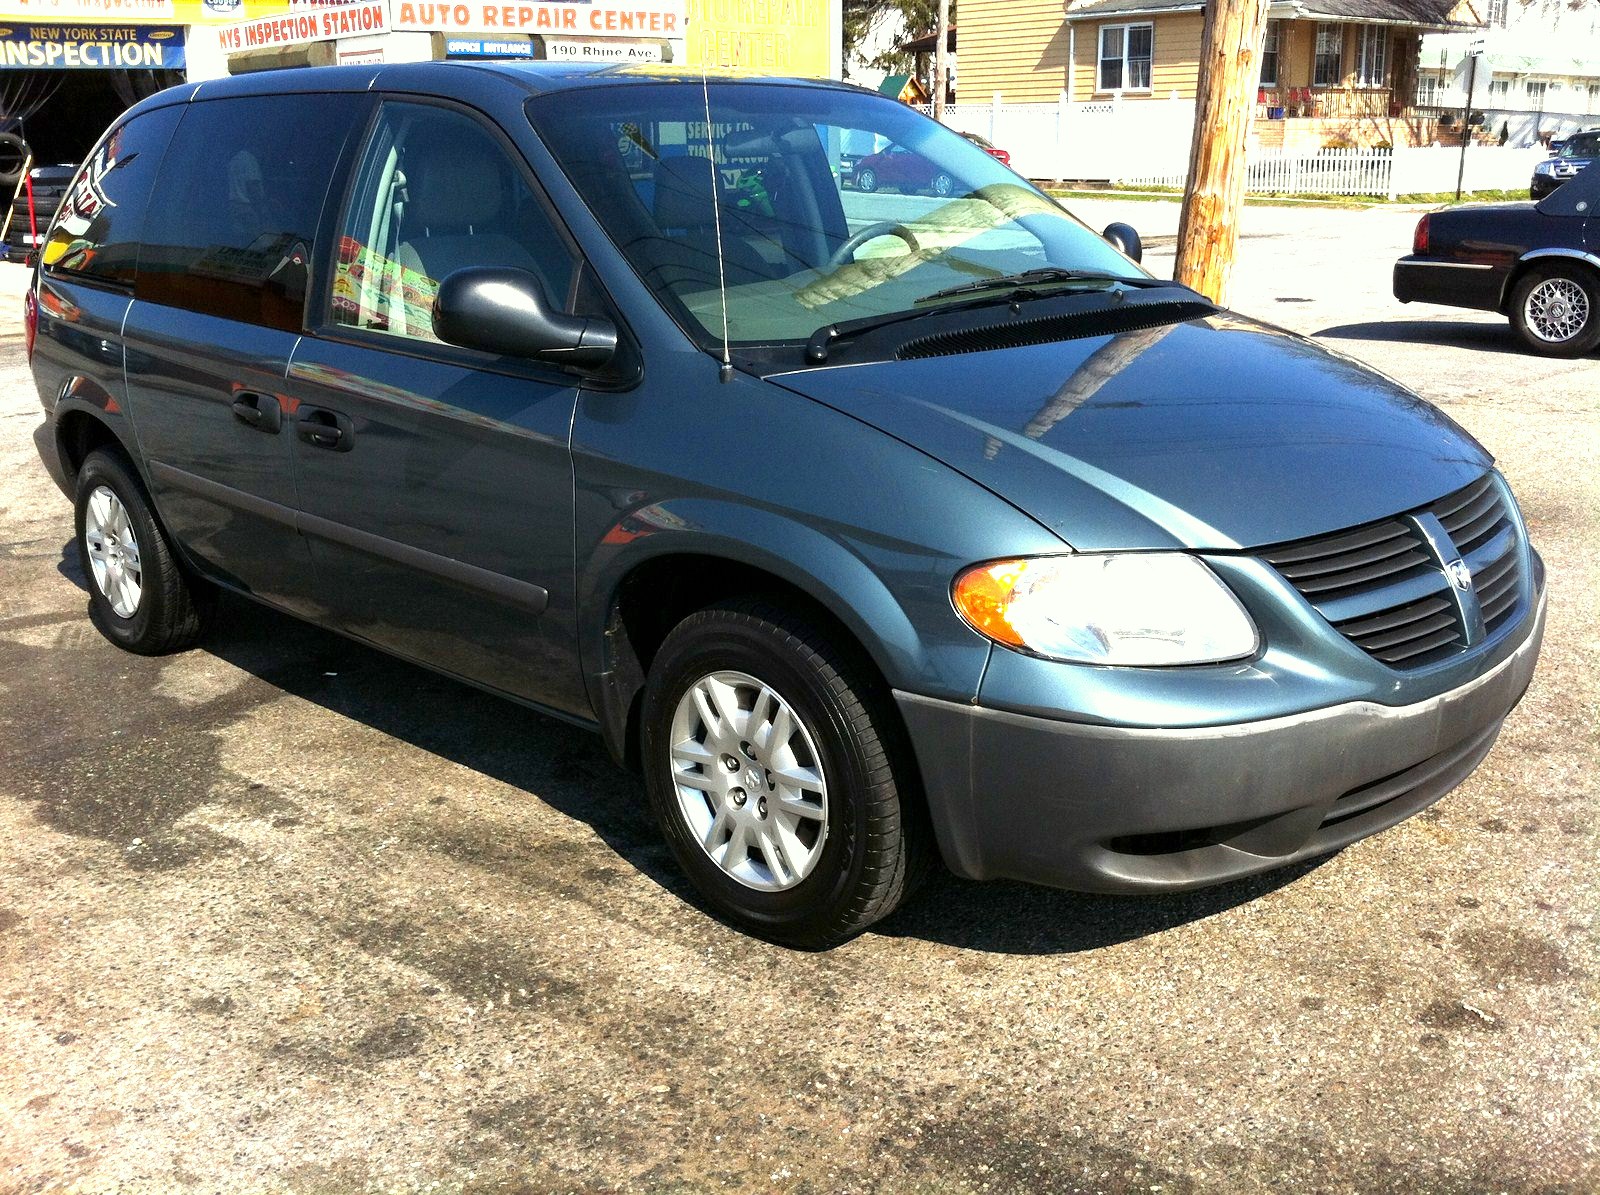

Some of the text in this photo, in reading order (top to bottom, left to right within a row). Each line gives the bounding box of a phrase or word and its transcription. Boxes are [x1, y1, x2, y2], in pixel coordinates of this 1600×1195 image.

[219, 5, 383, 49] NYS INSPECTION STATION
[400, 2, 677, 32] AUTO REPAIR CENTER
[30, 27, 59, 39] NEW
[63, 28, 97, 40] YORK
[101, 29, 137, 41] STATE
[0, 40, 163, 66] INSPECTION
[448, 41, 531, 54] OFFICE ENTRANCE
[551, 45, 656, 58] 190 Rhine Ave.
[703, 30, 790, 67] CENTER
